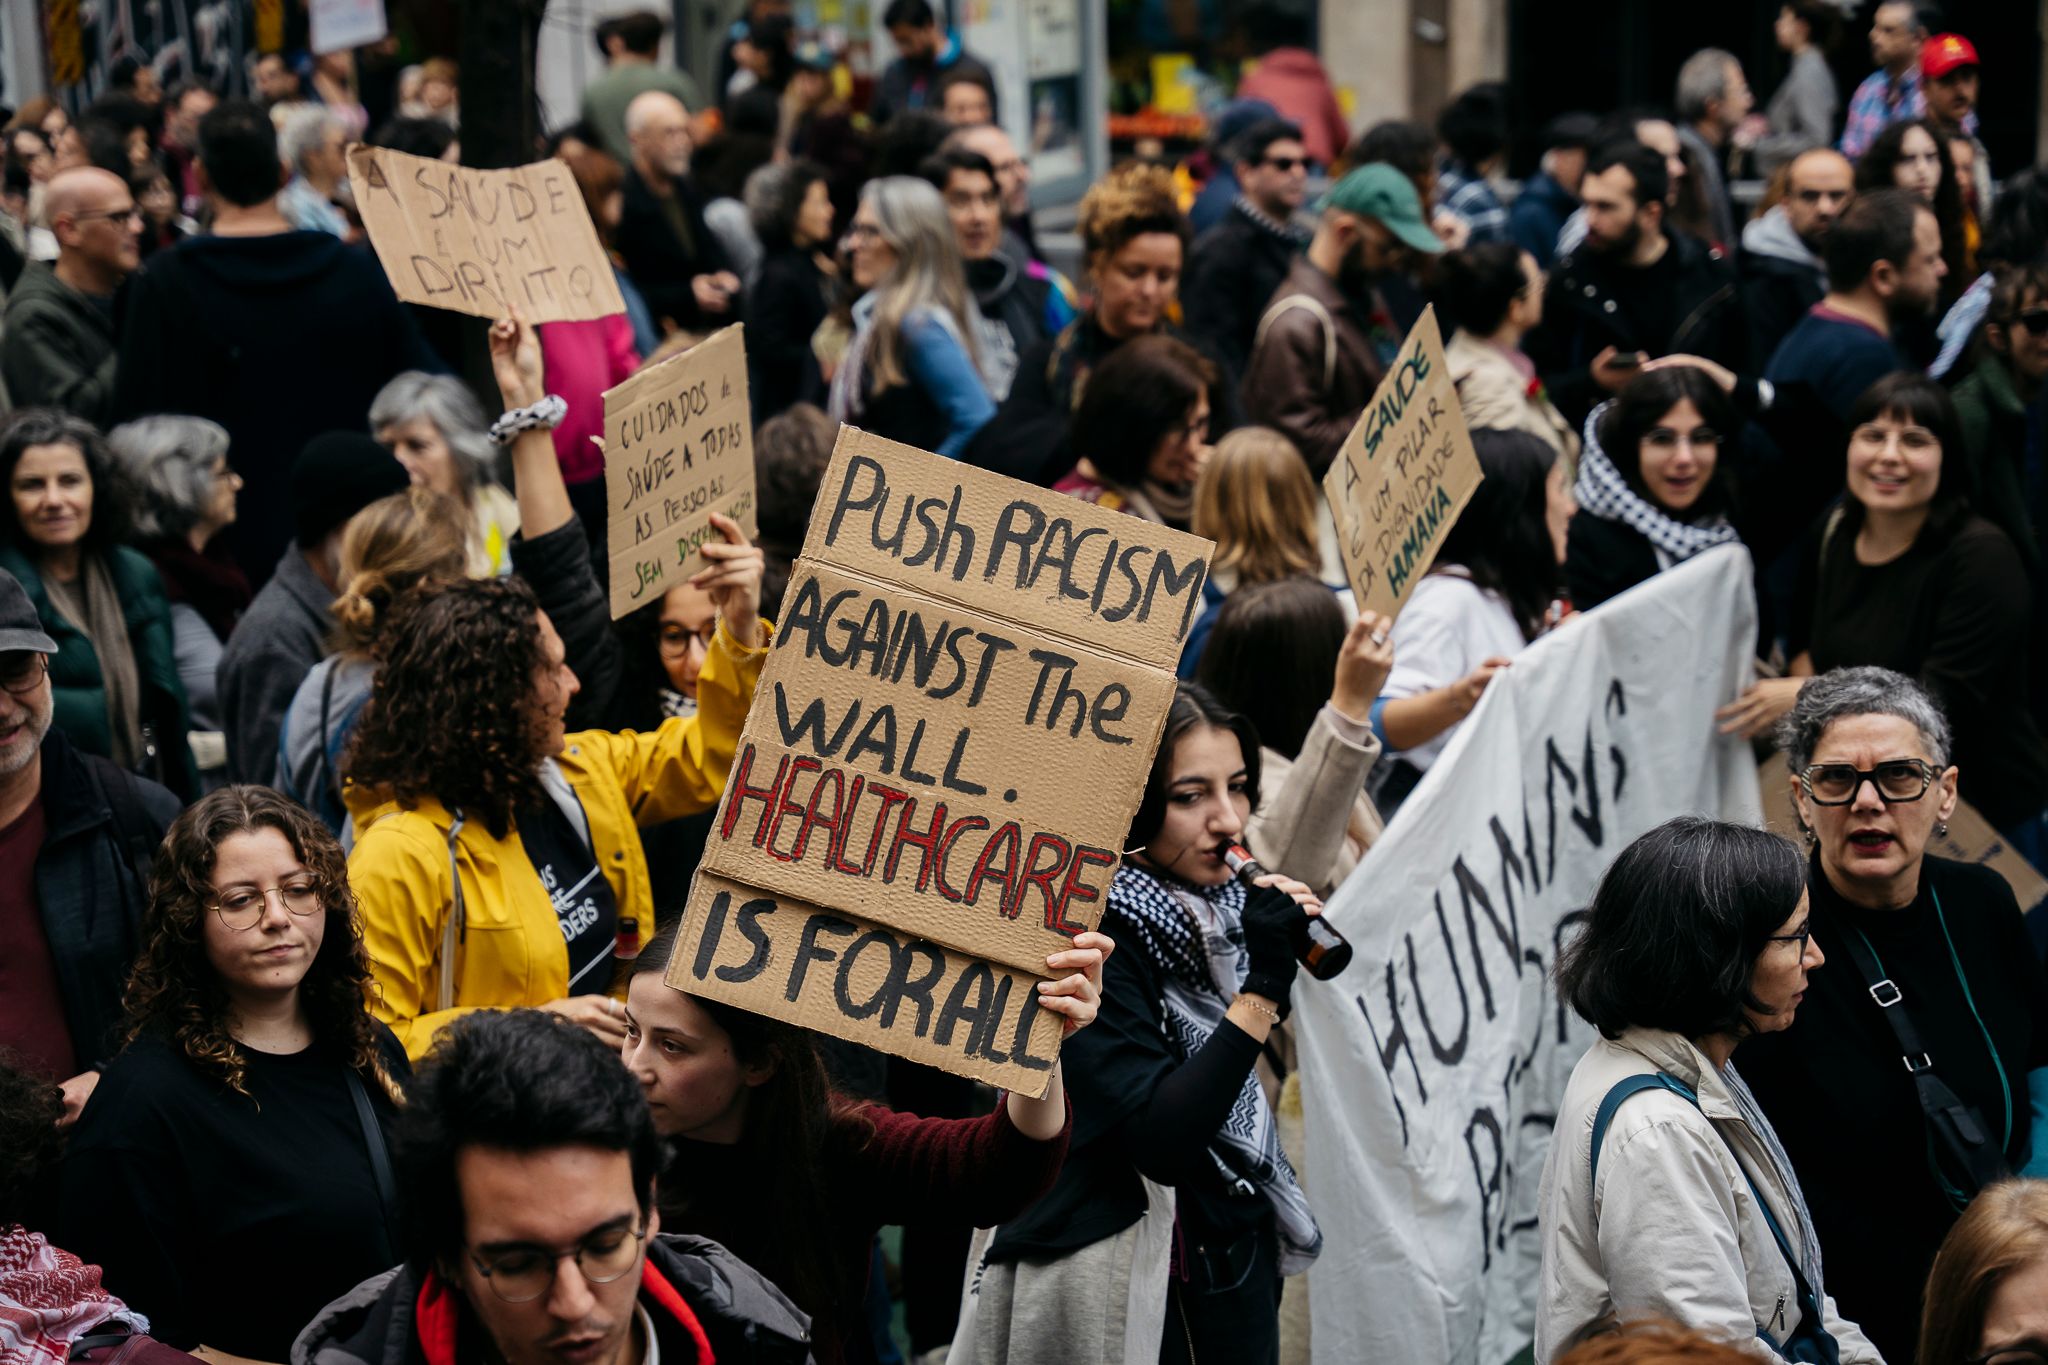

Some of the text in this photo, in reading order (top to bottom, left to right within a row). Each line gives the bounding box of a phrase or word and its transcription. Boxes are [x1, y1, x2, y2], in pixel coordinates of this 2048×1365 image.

[367, 158, 567, 226] A SAÚDE
[472, 235, 537, 267] UM
[623, 421, 742, 511] SAÚDE A TODAS
[1345, 453, 1362, 502] A
[1370, 478, 1393, 523] UM
[634, 474, 725, 546] AS PESSOAS
[1386, 483, 1453, 599] HUMANA
[630, 556, 664, 599] SEM
[983, 499, 1206, 644] RACISM
[775, 575, 1133, 746] AGAINST The
[719, 742, 1118, 937] HEALTHCARE
[691, 890, 778, 983] IS
